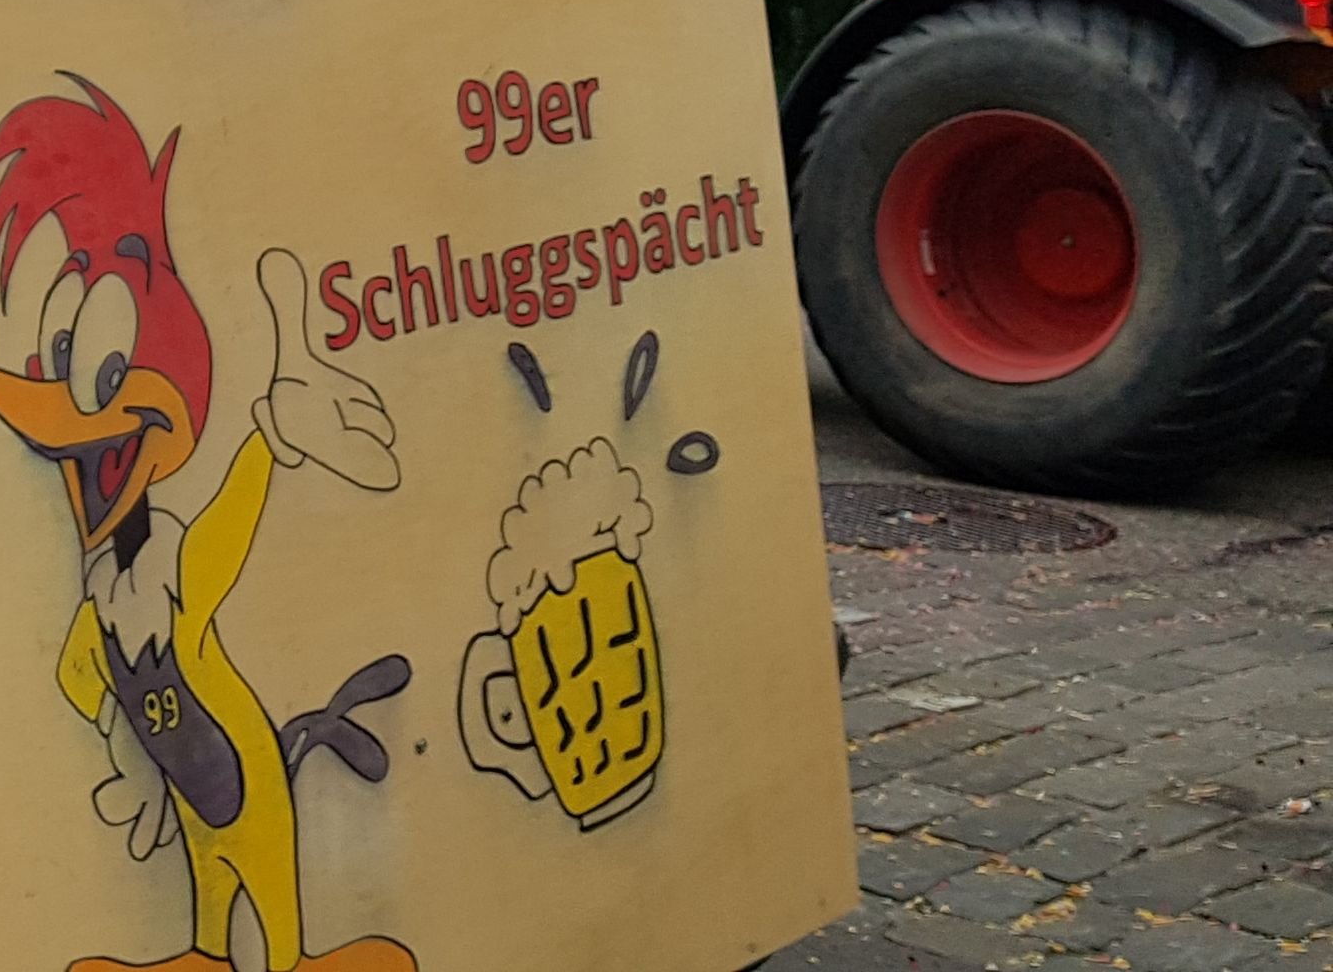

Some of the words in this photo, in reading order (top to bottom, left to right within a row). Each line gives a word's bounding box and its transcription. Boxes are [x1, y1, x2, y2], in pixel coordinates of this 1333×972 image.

[457, 70, 599, 164] 99er
[319, 174, 763, 351] Schluggspächt
[142, 684, 182, 736] 99
